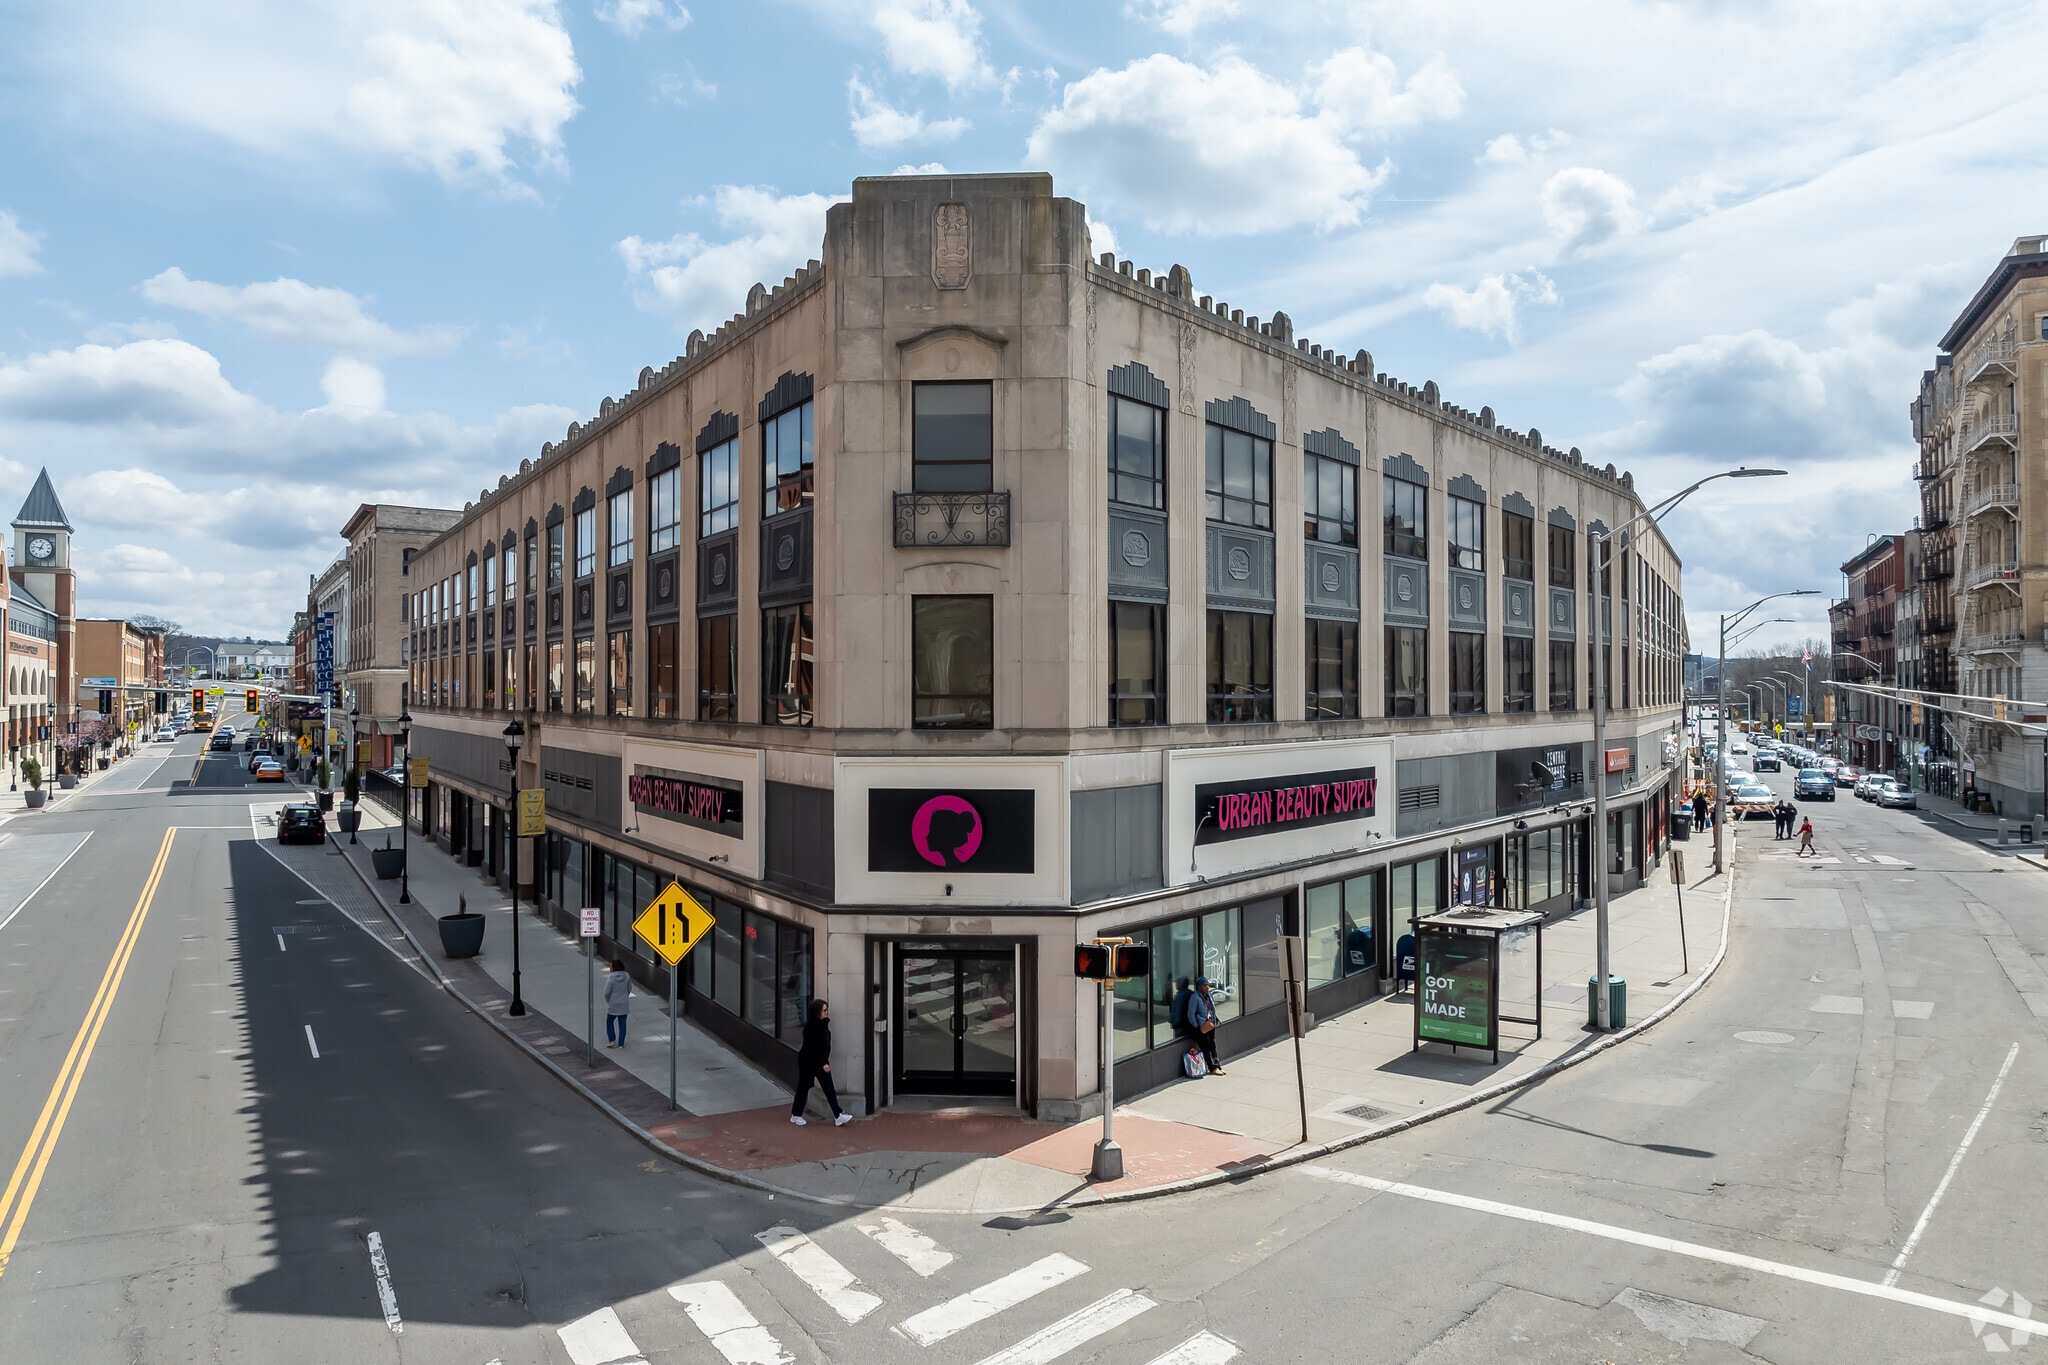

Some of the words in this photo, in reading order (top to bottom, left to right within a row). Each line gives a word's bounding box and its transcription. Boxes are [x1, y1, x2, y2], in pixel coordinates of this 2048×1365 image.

[325, 630, 334, 690] PALACE
[1546, 751, 1566, 766] CENTRAL
[628, 775, 653, 807] URBAN
[654, 780, 687, 814] BEAUTY
[687, 785, 723, 824] SUPPLY
[1218, 791, 1272, 831] URBAN
[1276, 784, 1330, 822] BEAUTY
[1333, 778, 1377, 813] SUPPLY
[1426, 963, 1430, 974] I
[1425, 976, 1455, 990] GOT
[1425, 989, 1437, 1001] IT
[1425, 1001, 1466, 1018] MADE
